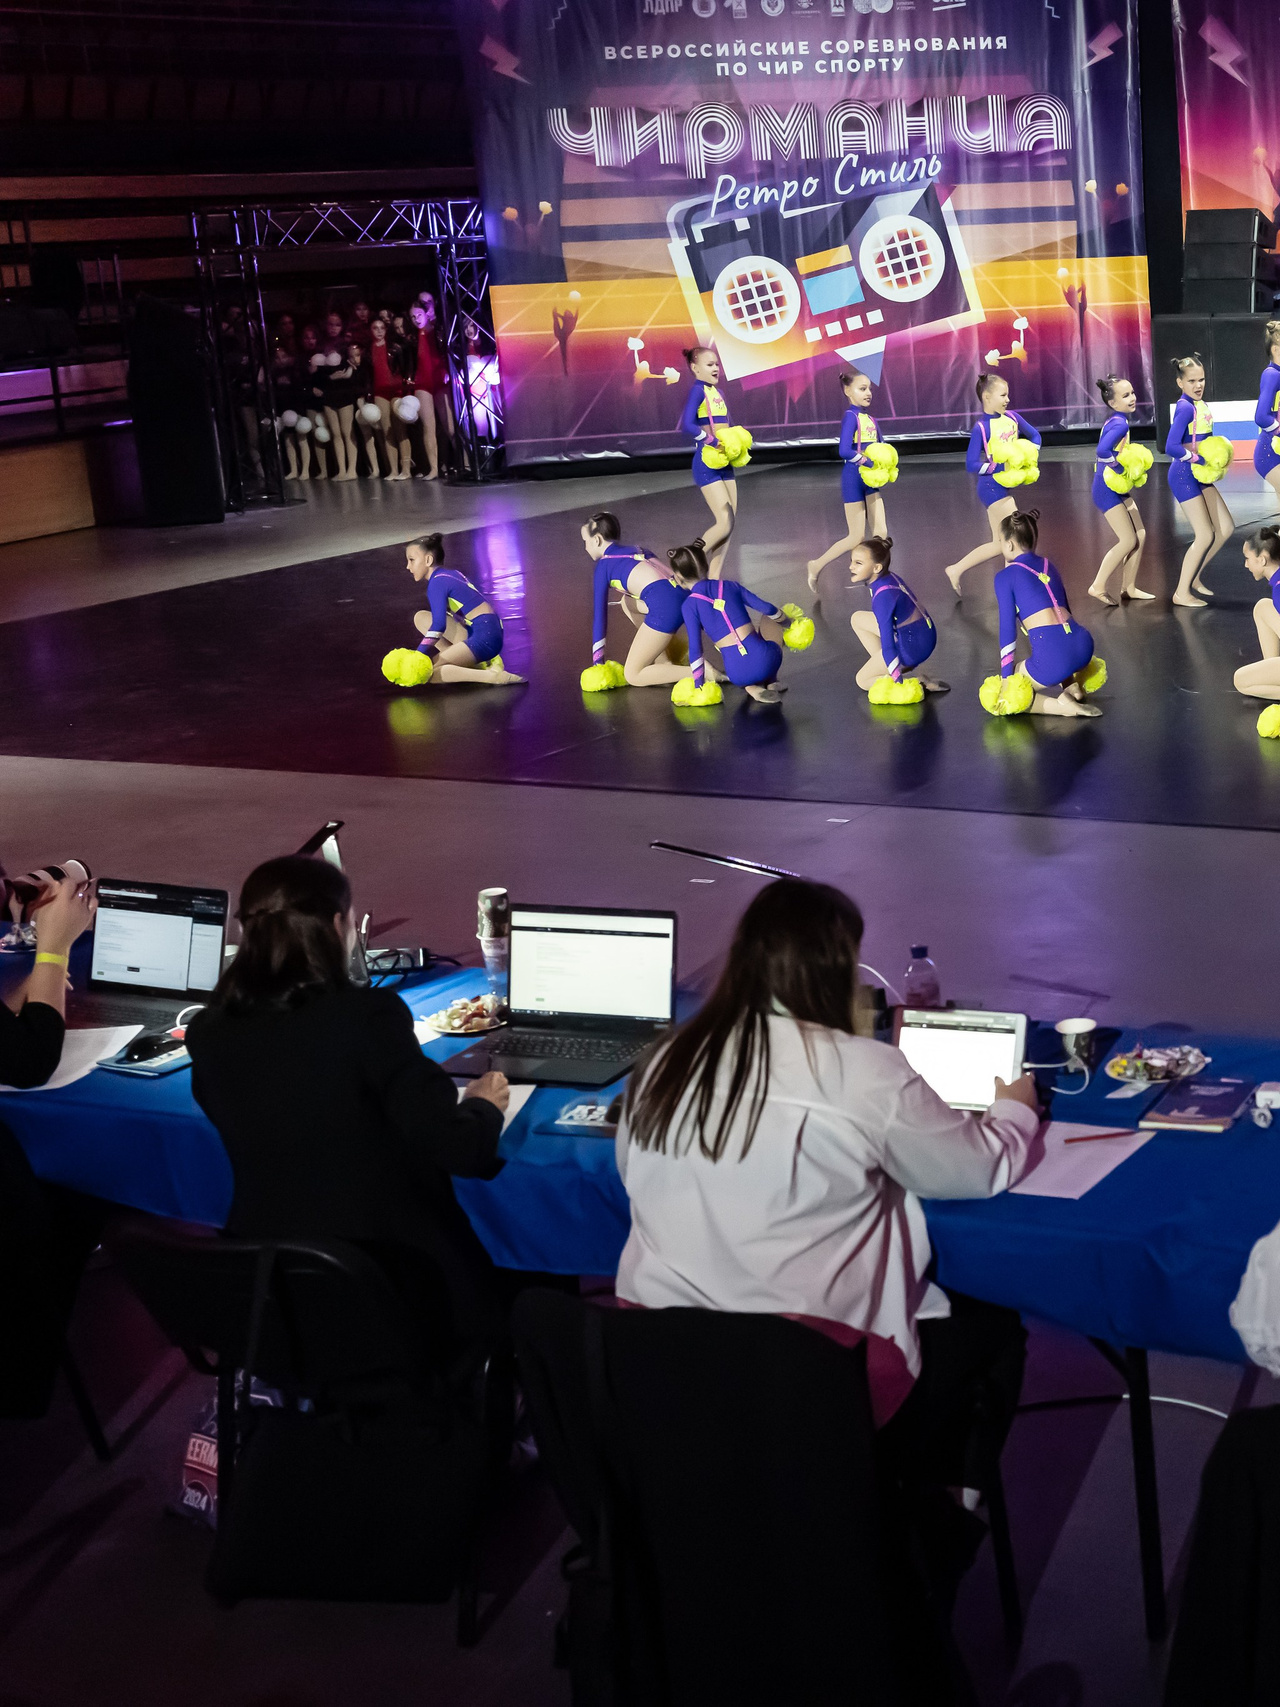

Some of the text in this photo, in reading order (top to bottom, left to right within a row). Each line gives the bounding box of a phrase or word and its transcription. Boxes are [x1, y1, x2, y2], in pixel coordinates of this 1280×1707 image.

[604, 36, 1008, 60] ВСЕРОССИЙСКИЕ СОРЕВНОВАНИЯ
[716, 58, 904, 76] ПО ЧИР СПОРТУ
[710, 153, 942, 217] Ретро Стиль
[183, 1487, 207, 1510] 2024
